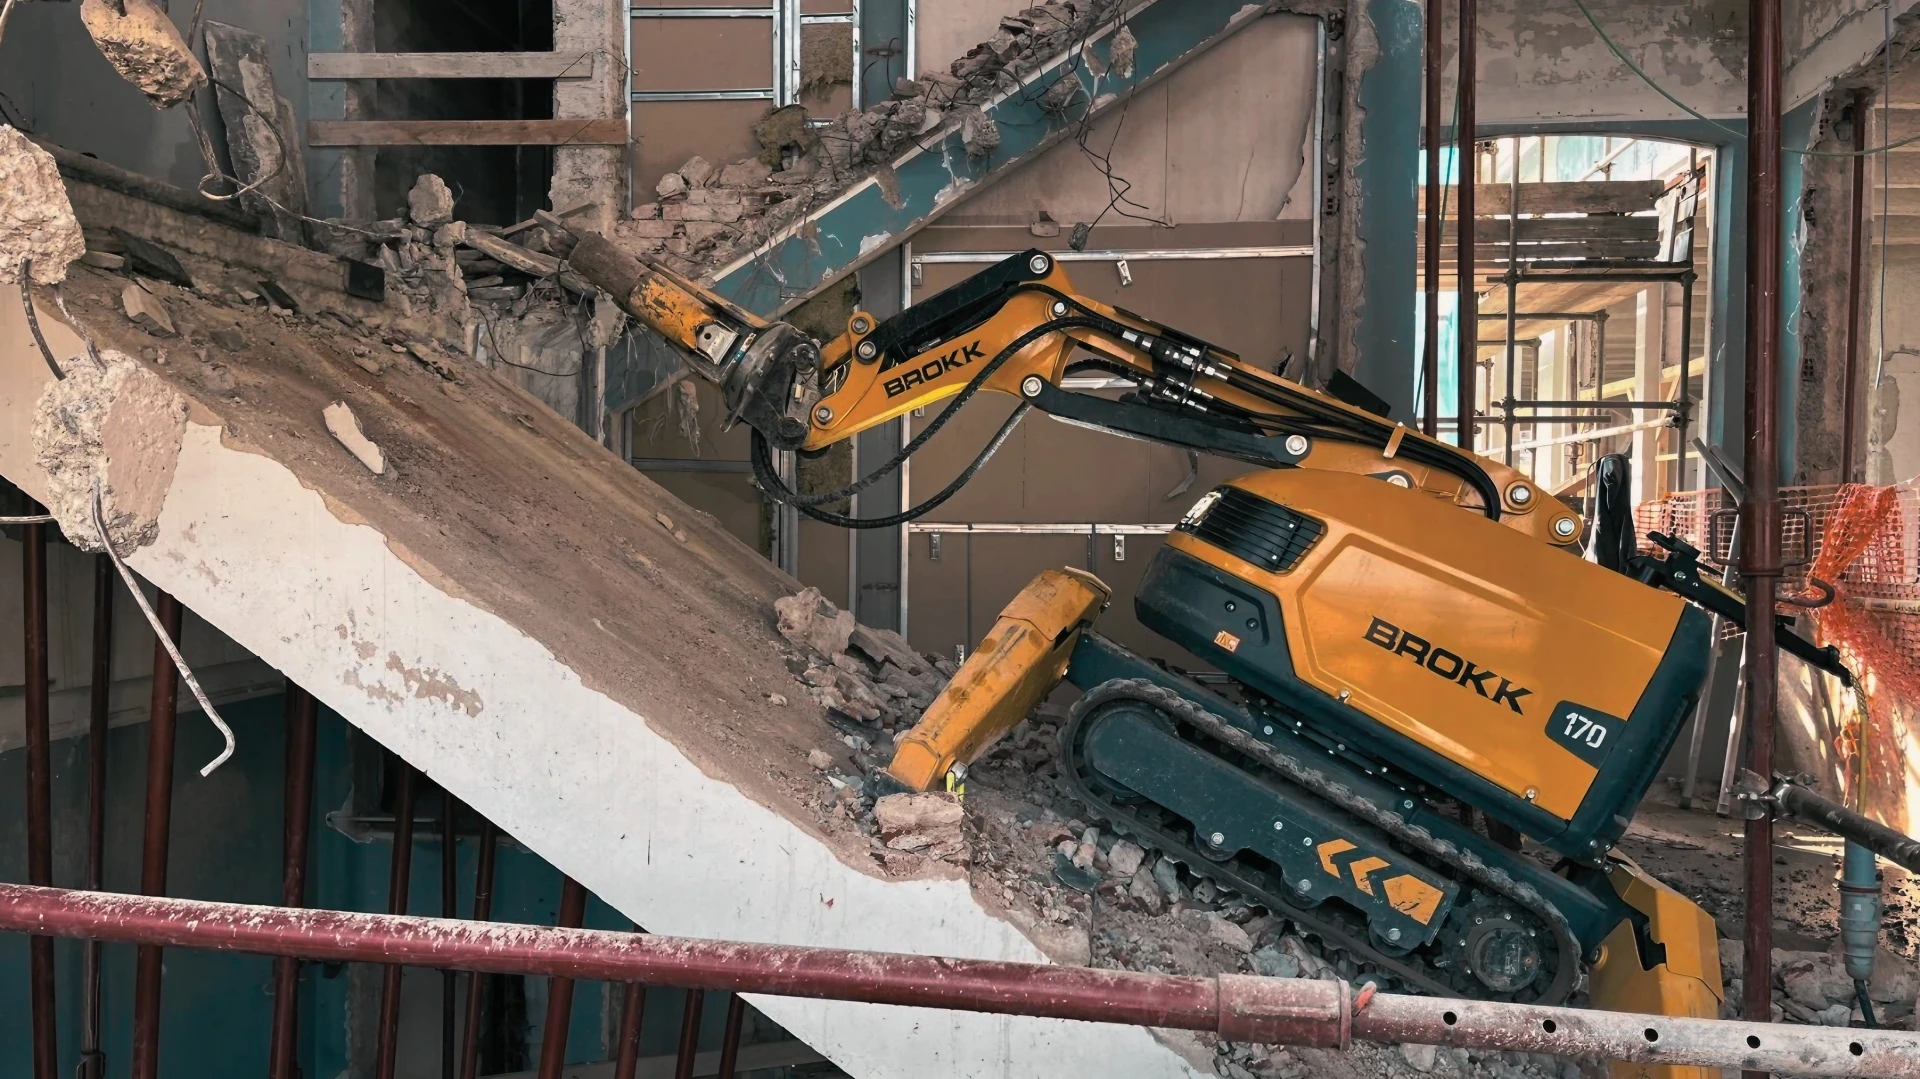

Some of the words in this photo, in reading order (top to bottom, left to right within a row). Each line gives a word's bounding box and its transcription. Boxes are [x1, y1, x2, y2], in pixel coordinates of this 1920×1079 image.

[884, 341, 985, 398] BROKK
[1363, 616, 1533, 715] BROKK
[1564, 712, 1607, 749] 170
